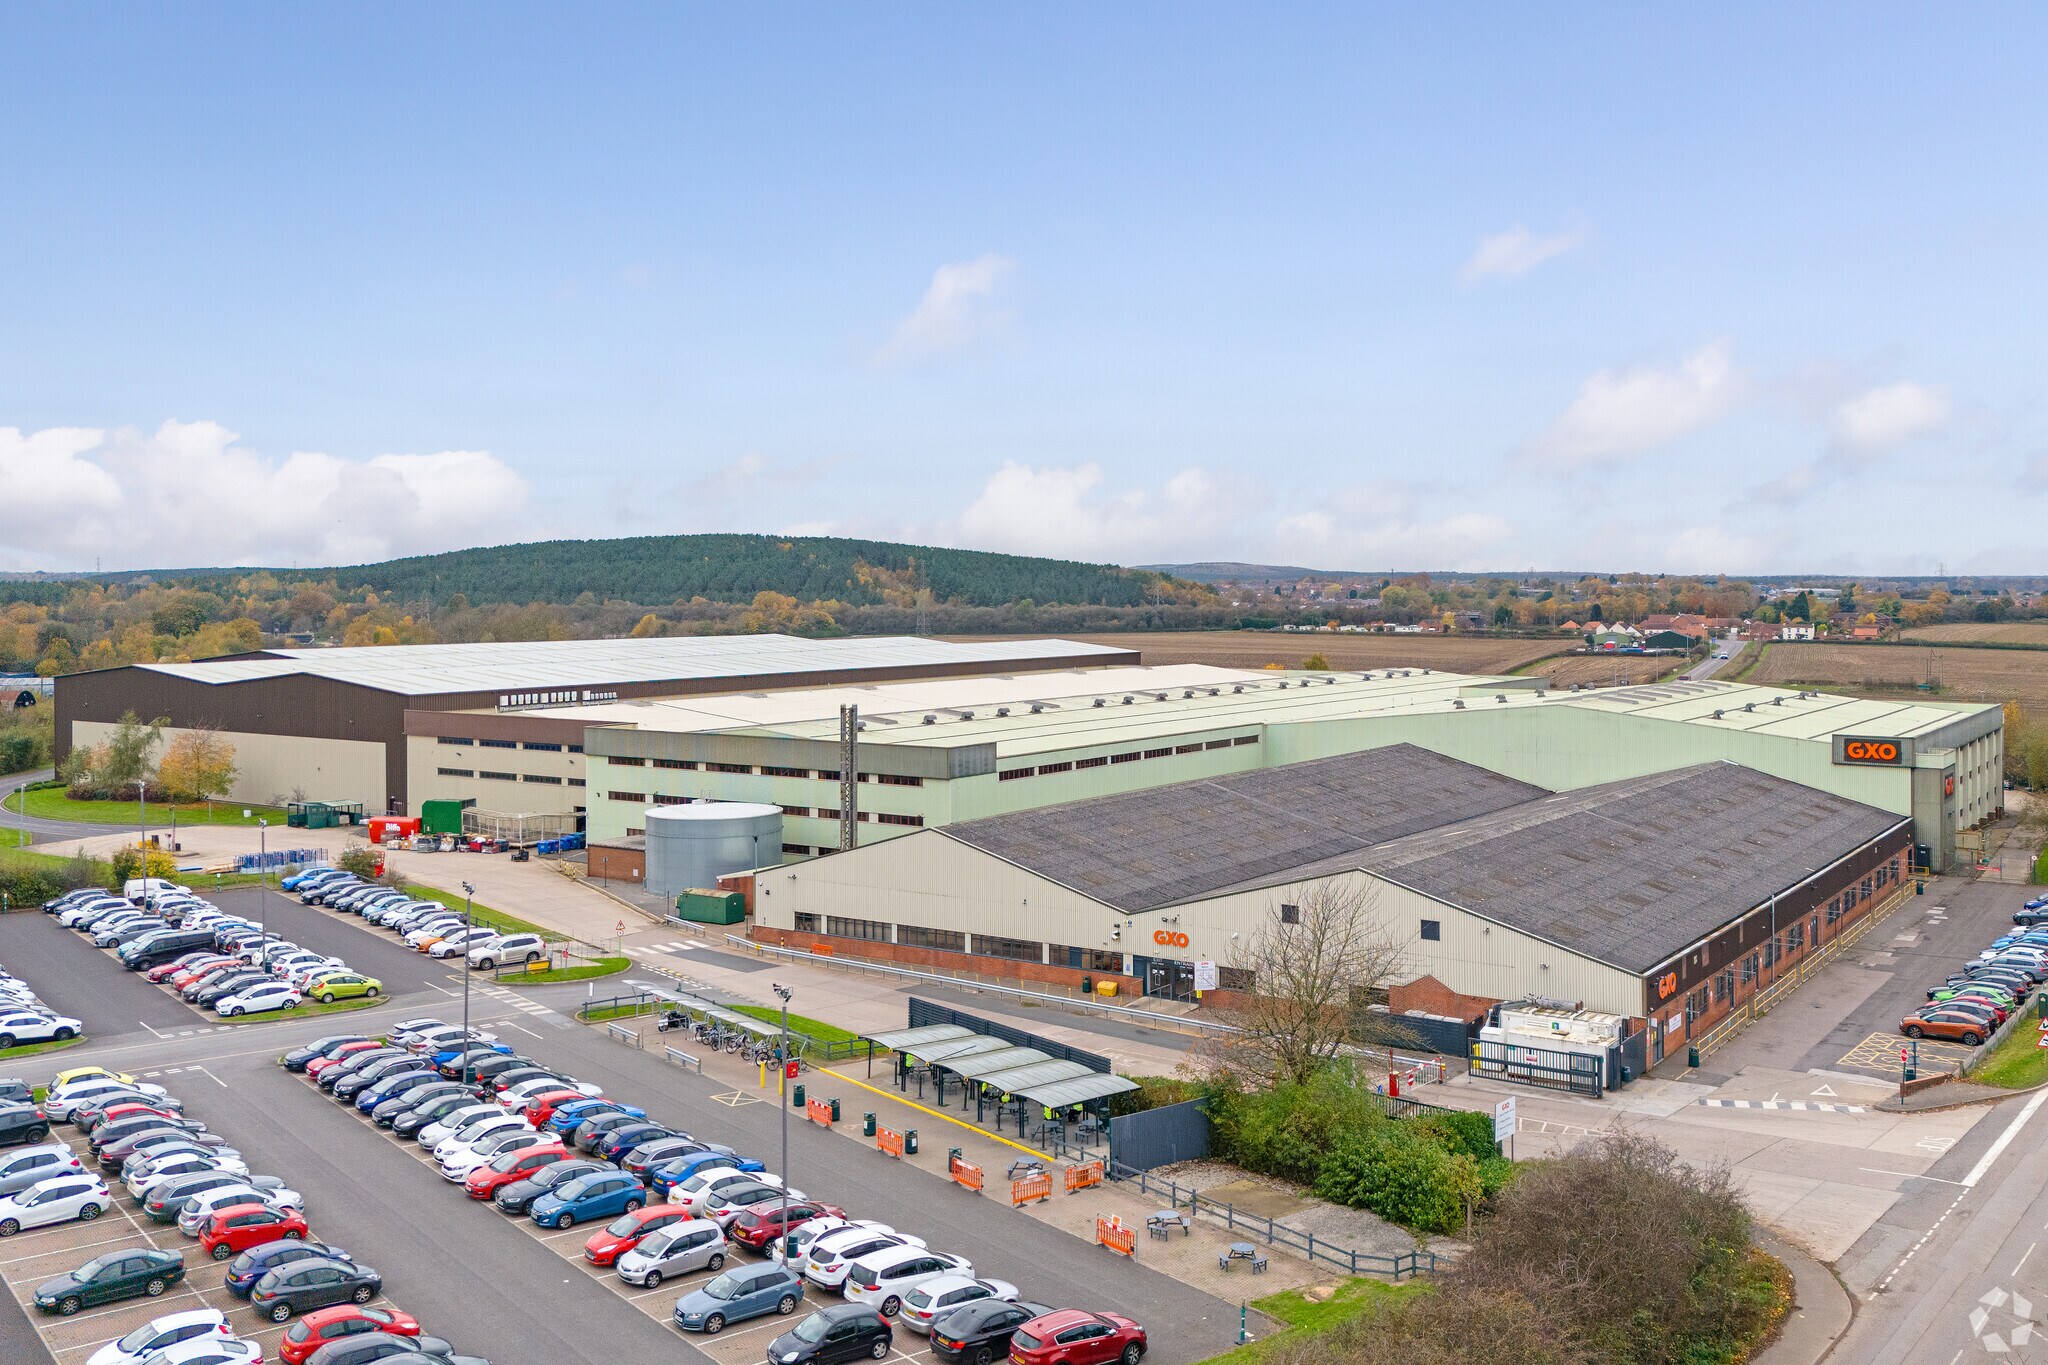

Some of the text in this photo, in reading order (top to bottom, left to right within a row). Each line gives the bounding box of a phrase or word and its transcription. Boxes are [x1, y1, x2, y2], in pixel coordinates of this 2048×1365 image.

[1847, 742, 1897, 760] GXO
[1153, 929, 1189, 949] GXO
[1659, 972, 1677, 999] GXO
